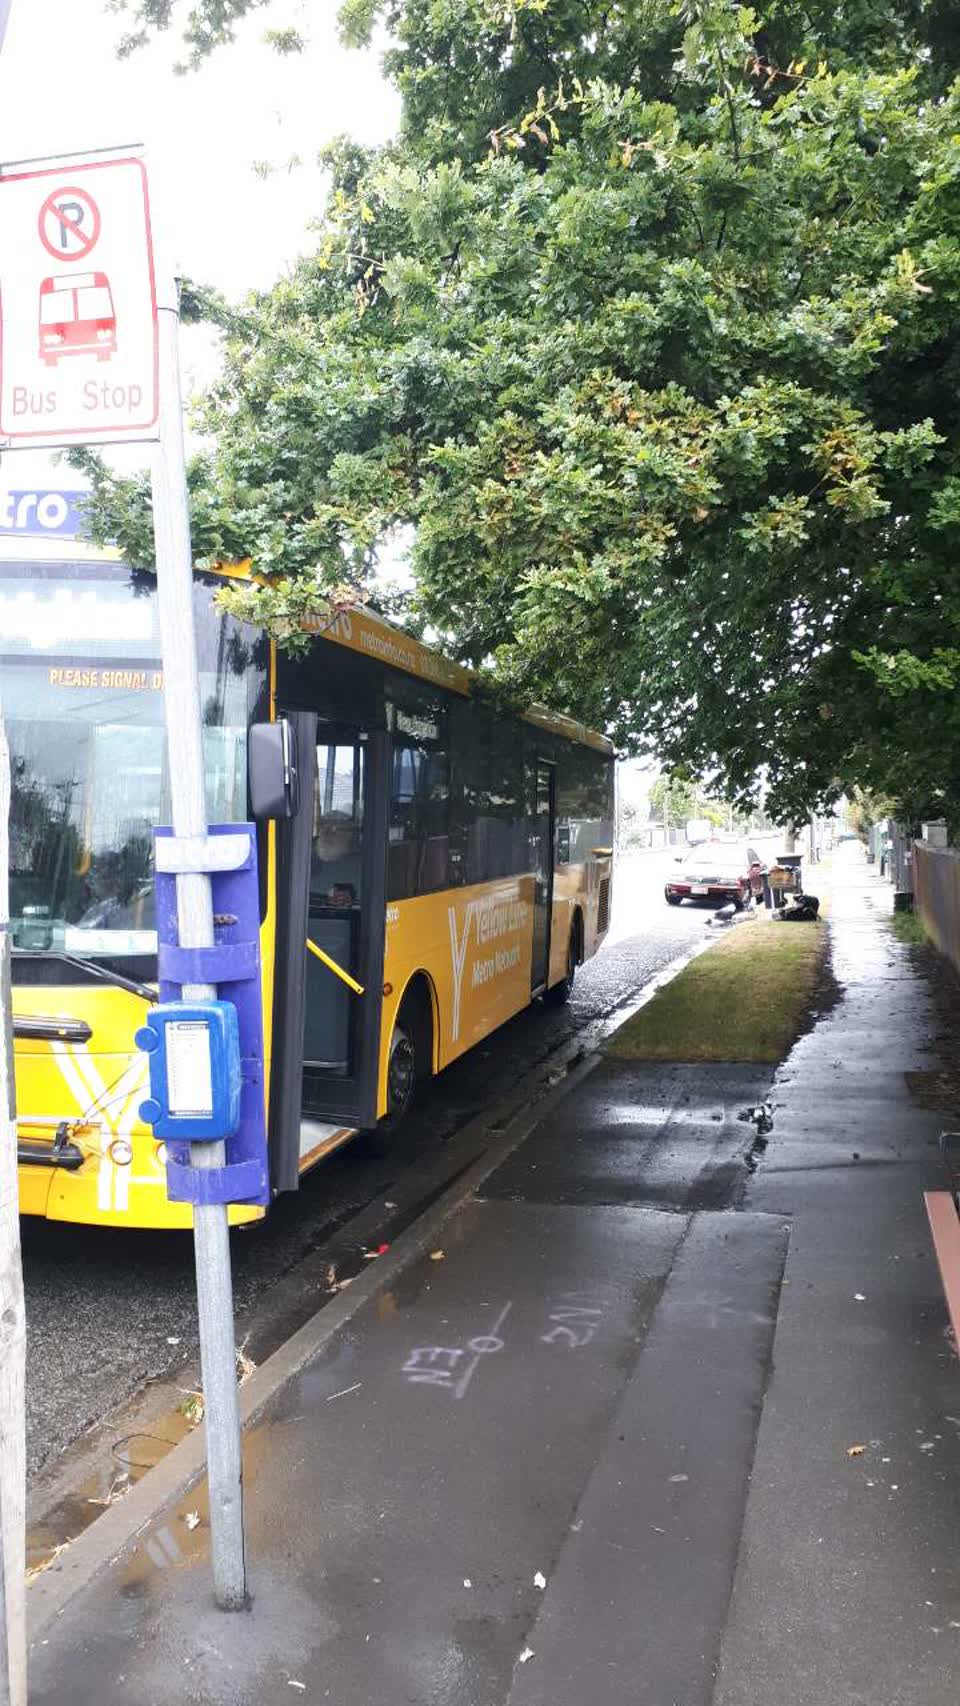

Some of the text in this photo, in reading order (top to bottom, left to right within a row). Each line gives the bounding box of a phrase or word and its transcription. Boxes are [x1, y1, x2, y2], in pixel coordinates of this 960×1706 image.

[12, 379, 143, 416] Bus Stop
[50, 668, 98, 687] PLEASE
[102, 671, 149, 690] SIGNAL
[475, 900, 507, 945] Yellow
[472, 957, 495, 987] Metro
